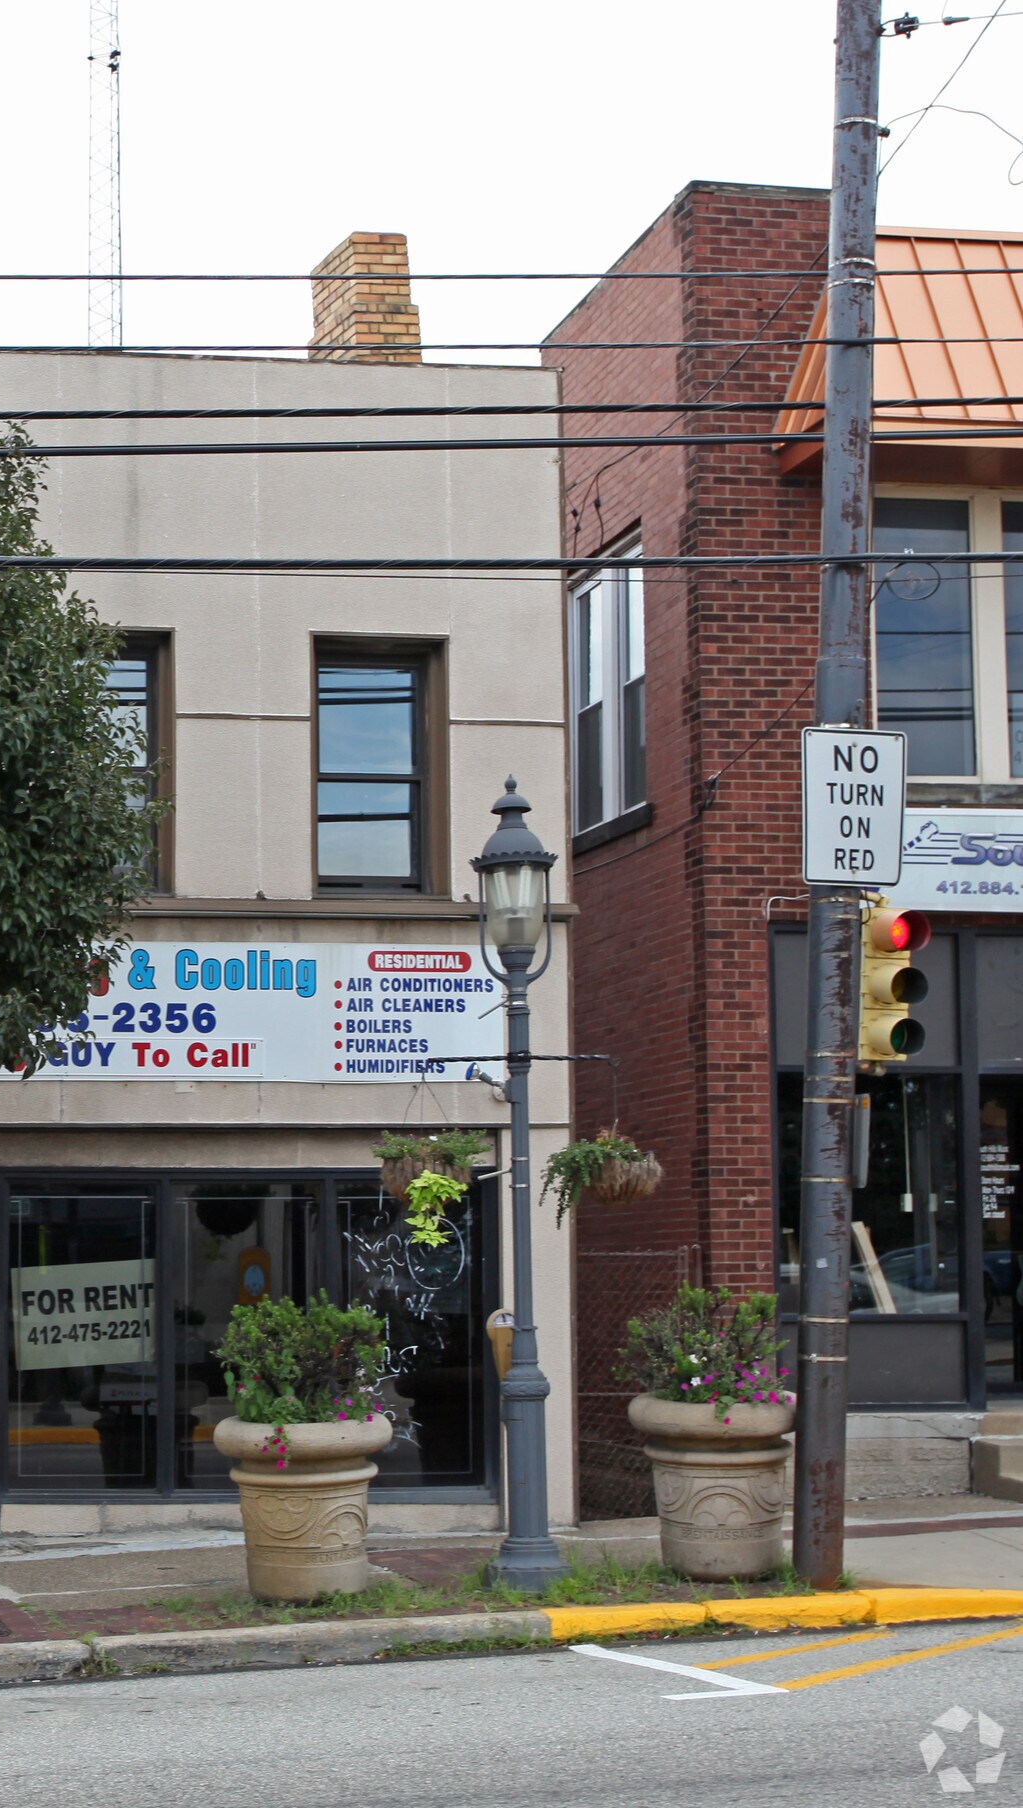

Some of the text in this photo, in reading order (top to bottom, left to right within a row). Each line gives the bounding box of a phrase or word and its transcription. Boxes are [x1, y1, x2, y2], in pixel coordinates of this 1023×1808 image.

[833, 745, 879, 773] NO
[826, 783, 884, 806] TURN
[840, 815, 871, 839] ON
[834, 848, 875, 871] RED
[936, 880, 1023, 896] 412.884.
[128, 949, 157, 990] &
[175, 949, 318, 998] Cooling
[374, 954, 464, 970] RESIDENTIAL
[346, 977, 494, 993] AIR CONDITIONERS
[347, 998, 466, 1013] AIR CLEANERS
[346, 1019, 412, 1034] BOILERS
[47, 1042, 116, 1067] GUY
[132, 1042, 170, 1068] To
[346, 1038, 428, 1053] FURNACES
[346, 1059, 446, 1074] HUMIDIFIERS
[22, 1283, 155, 1316] FOR RENT
[27, 1319, 152, 1346] 412-475-2221
